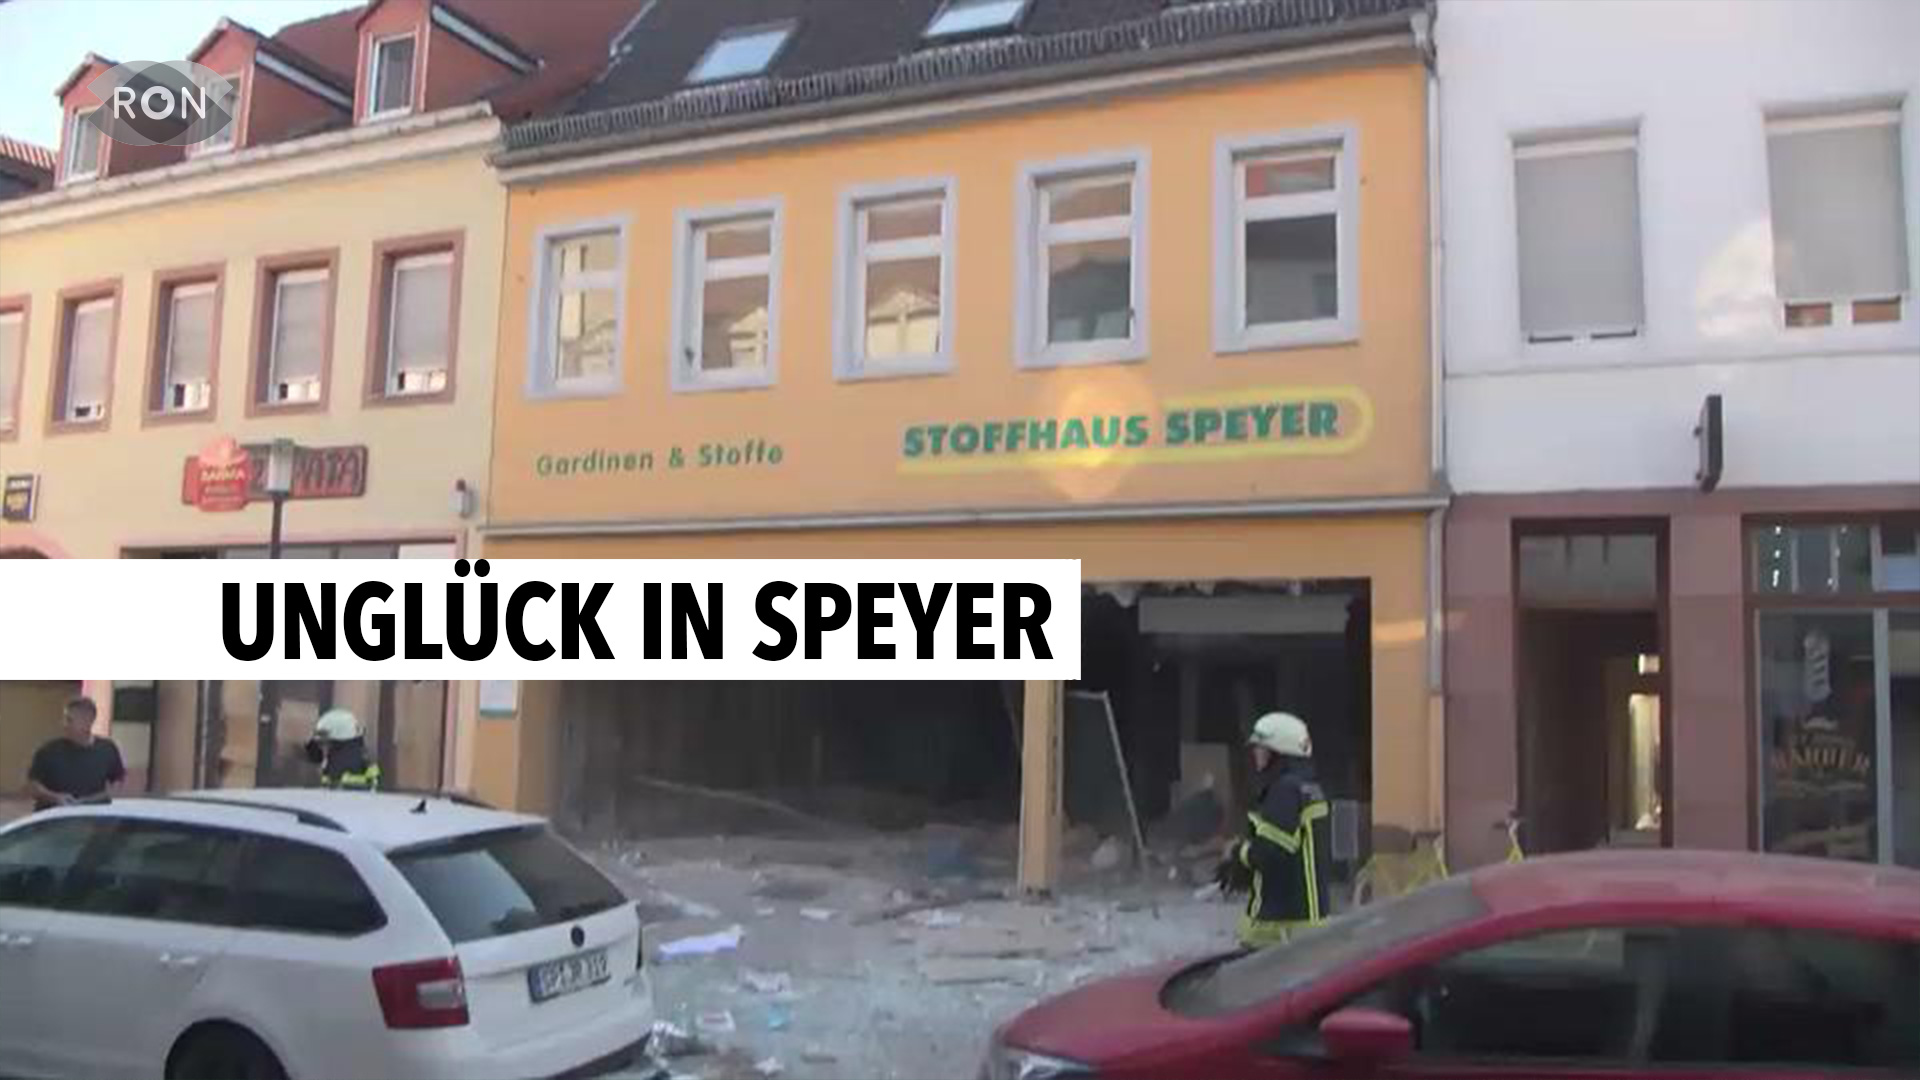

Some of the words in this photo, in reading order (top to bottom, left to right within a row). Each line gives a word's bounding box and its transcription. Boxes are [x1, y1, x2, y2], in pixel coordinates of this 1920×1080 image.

[903, 413, 1150, 457] STOFFHAUS
[1165, 402, 1339, 446] SPEYER
[536, 449, 654, 476] Gardinen
[669, 447, 684, 468] &
[698, 438, 783, 466] Stoffe
